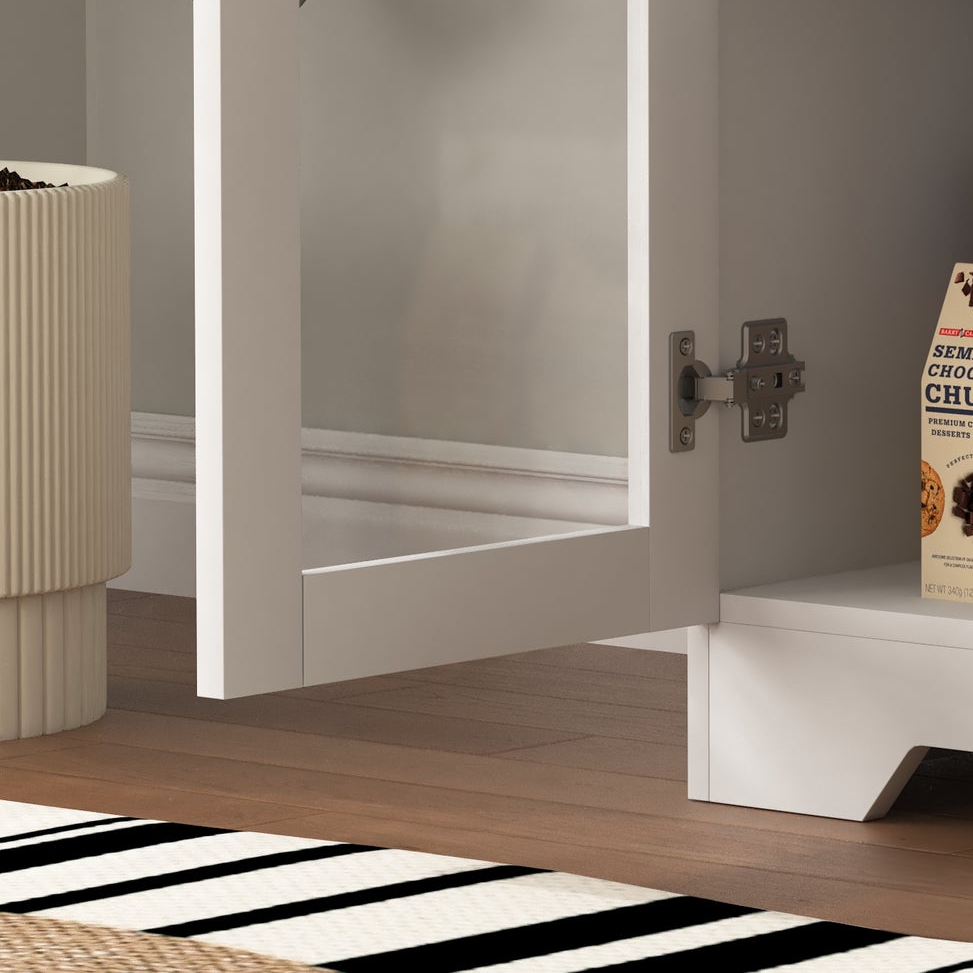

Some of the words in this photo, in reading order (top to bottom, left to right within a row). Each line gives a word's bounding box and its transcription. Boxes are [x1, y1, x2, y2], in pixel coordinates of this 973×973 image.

[940, 329, 959, 337] BARRY
[928, 417, 966, 428] PREMIUM
[931, 429, 971, 439] DESSERTS
[946, 453, 973, 469] PERFECT
